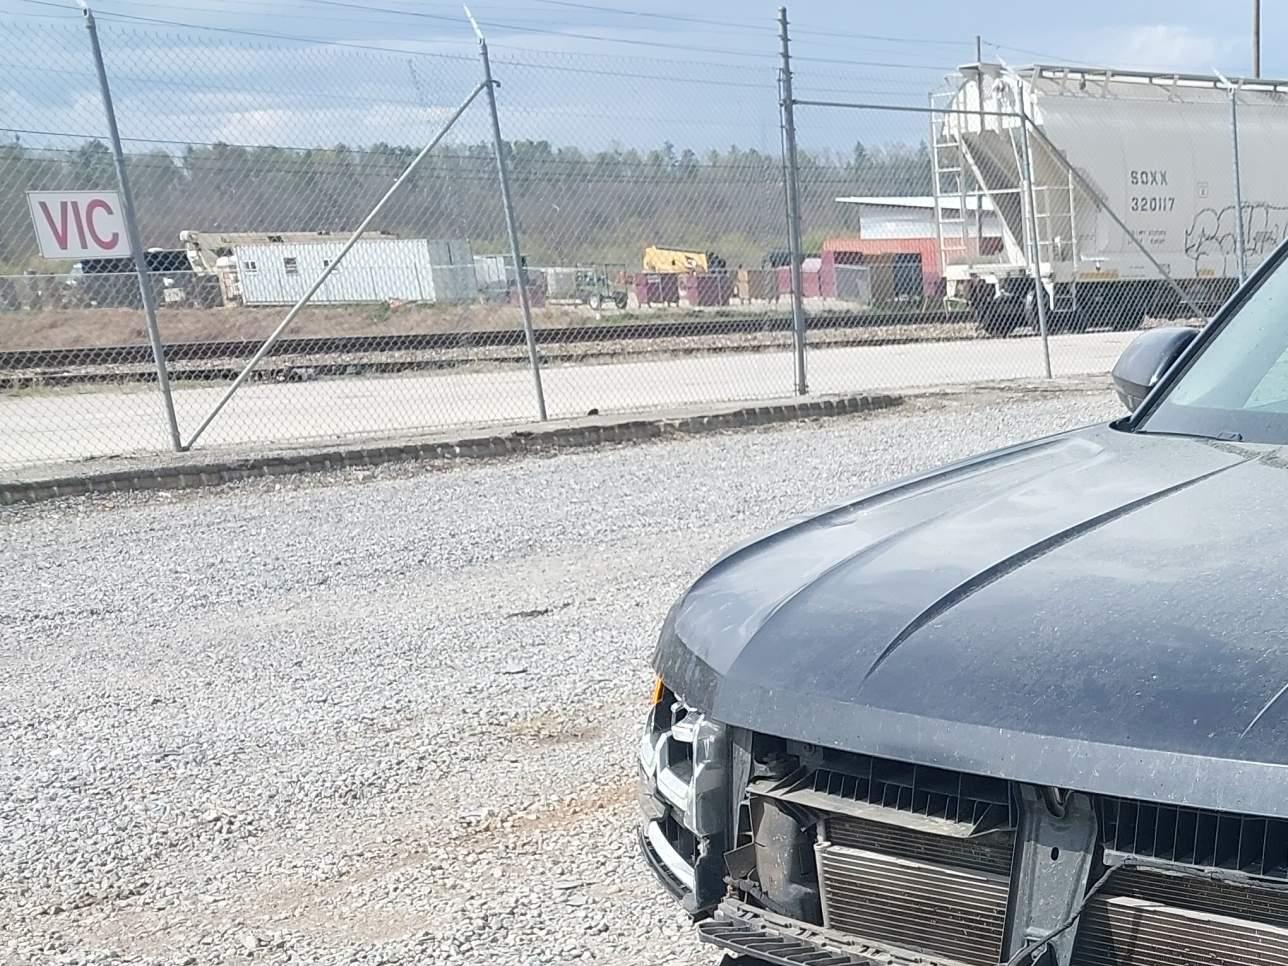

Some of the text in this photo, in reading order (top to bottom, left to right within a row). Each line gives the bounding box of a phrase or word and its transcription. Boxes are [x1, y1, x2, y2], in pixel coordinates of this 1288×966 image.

[1130, 170, 1168, 186] SOXX
[1131, 197, 1175, 212] 320117
[38, 199, 119, 250] VIC
